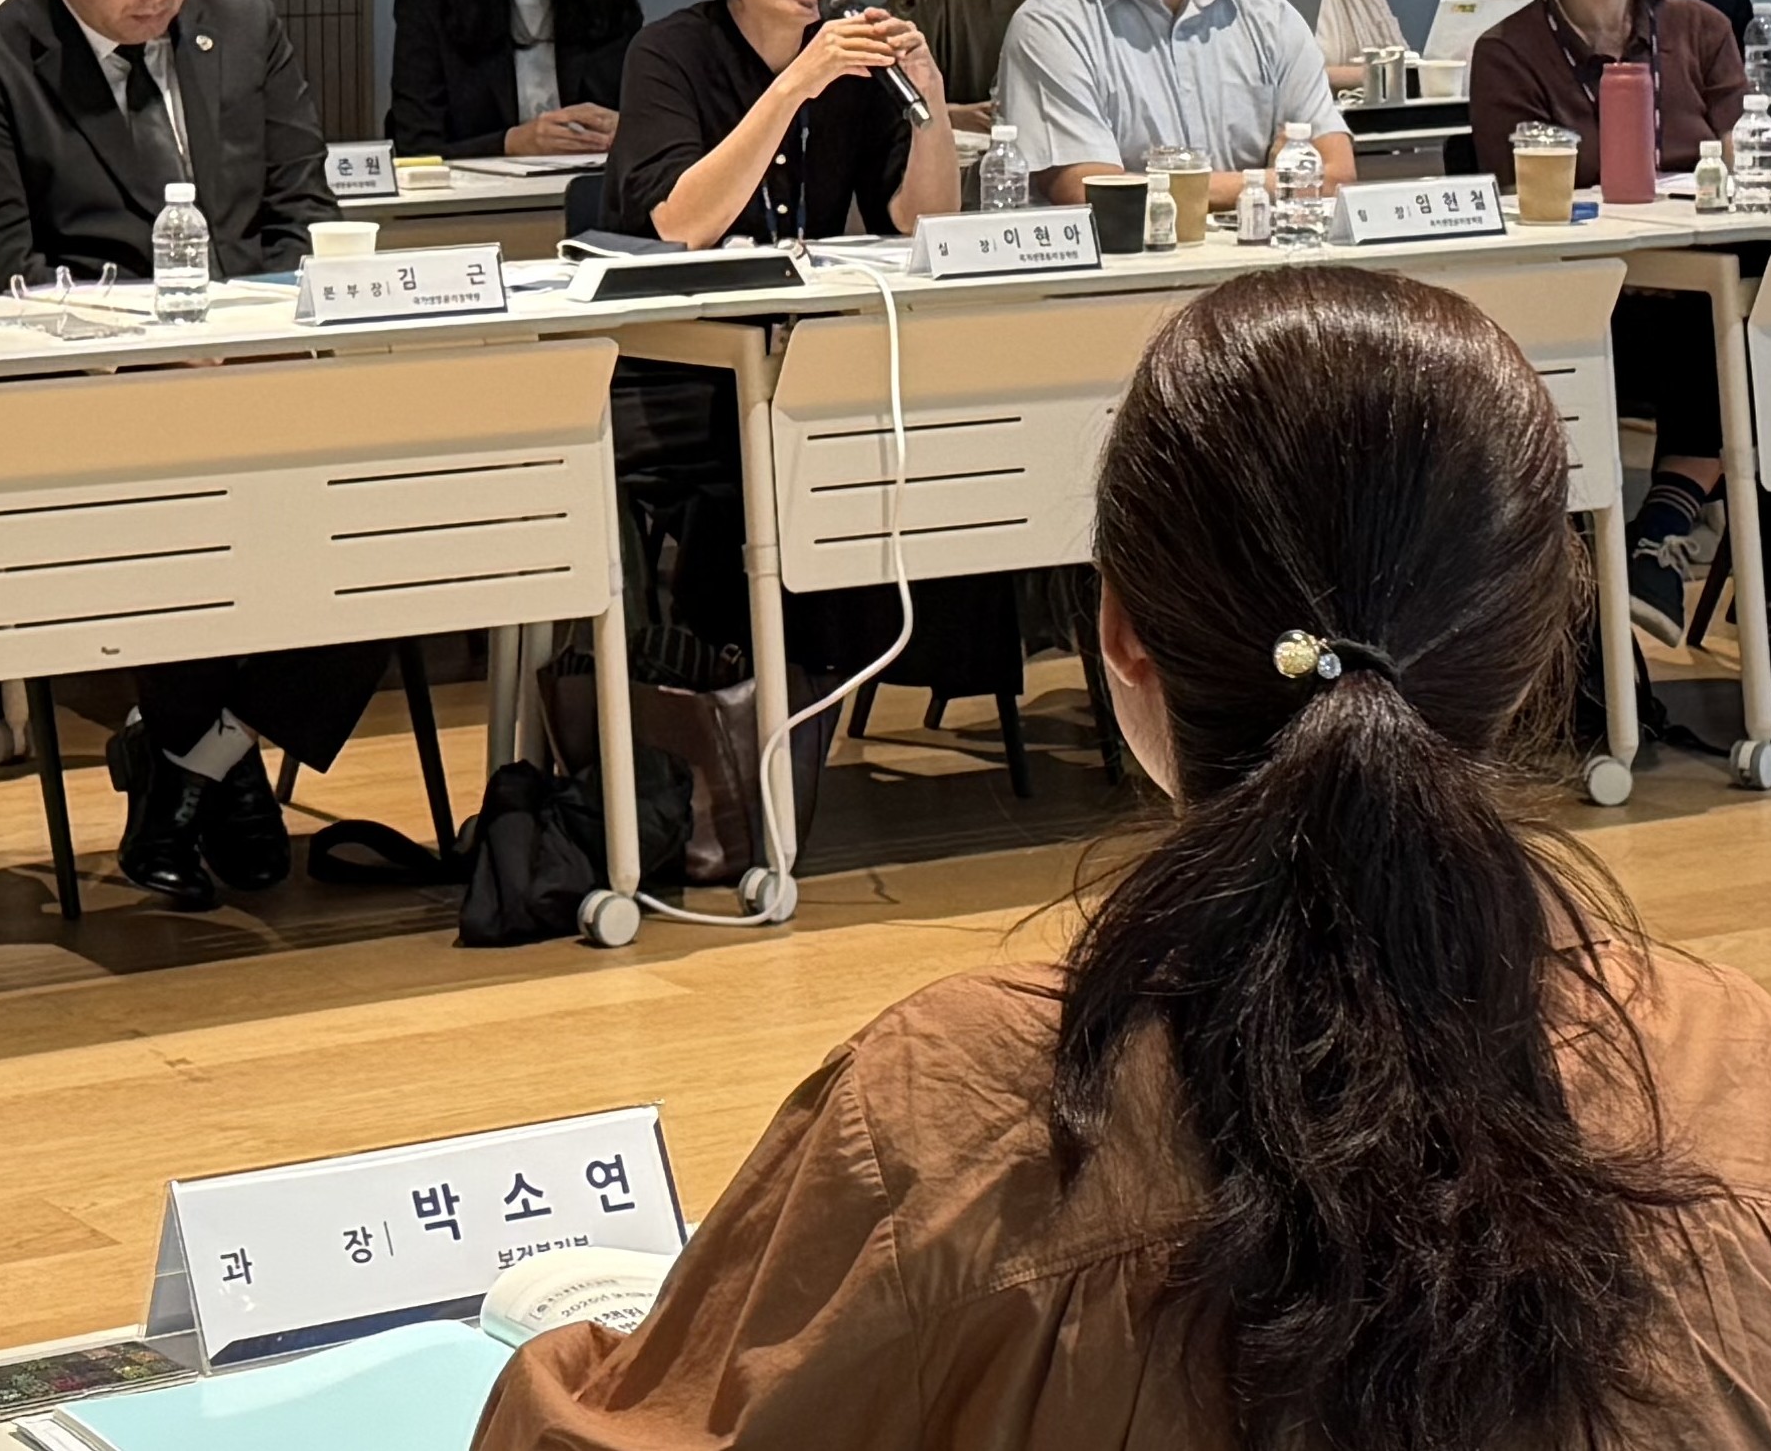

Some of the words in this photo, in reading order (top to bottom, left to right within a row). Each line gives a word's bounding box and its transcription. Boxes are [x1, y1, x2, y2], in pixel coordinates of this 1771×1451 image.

[337, 155, 381, 176] 준원
[1003, 223, 1080, 248] 이현아
[397, 263, 486, 291] 김근
[220, 1225, 374, 1285] 과장
[411, 1153, 636, 1242] 박소연
